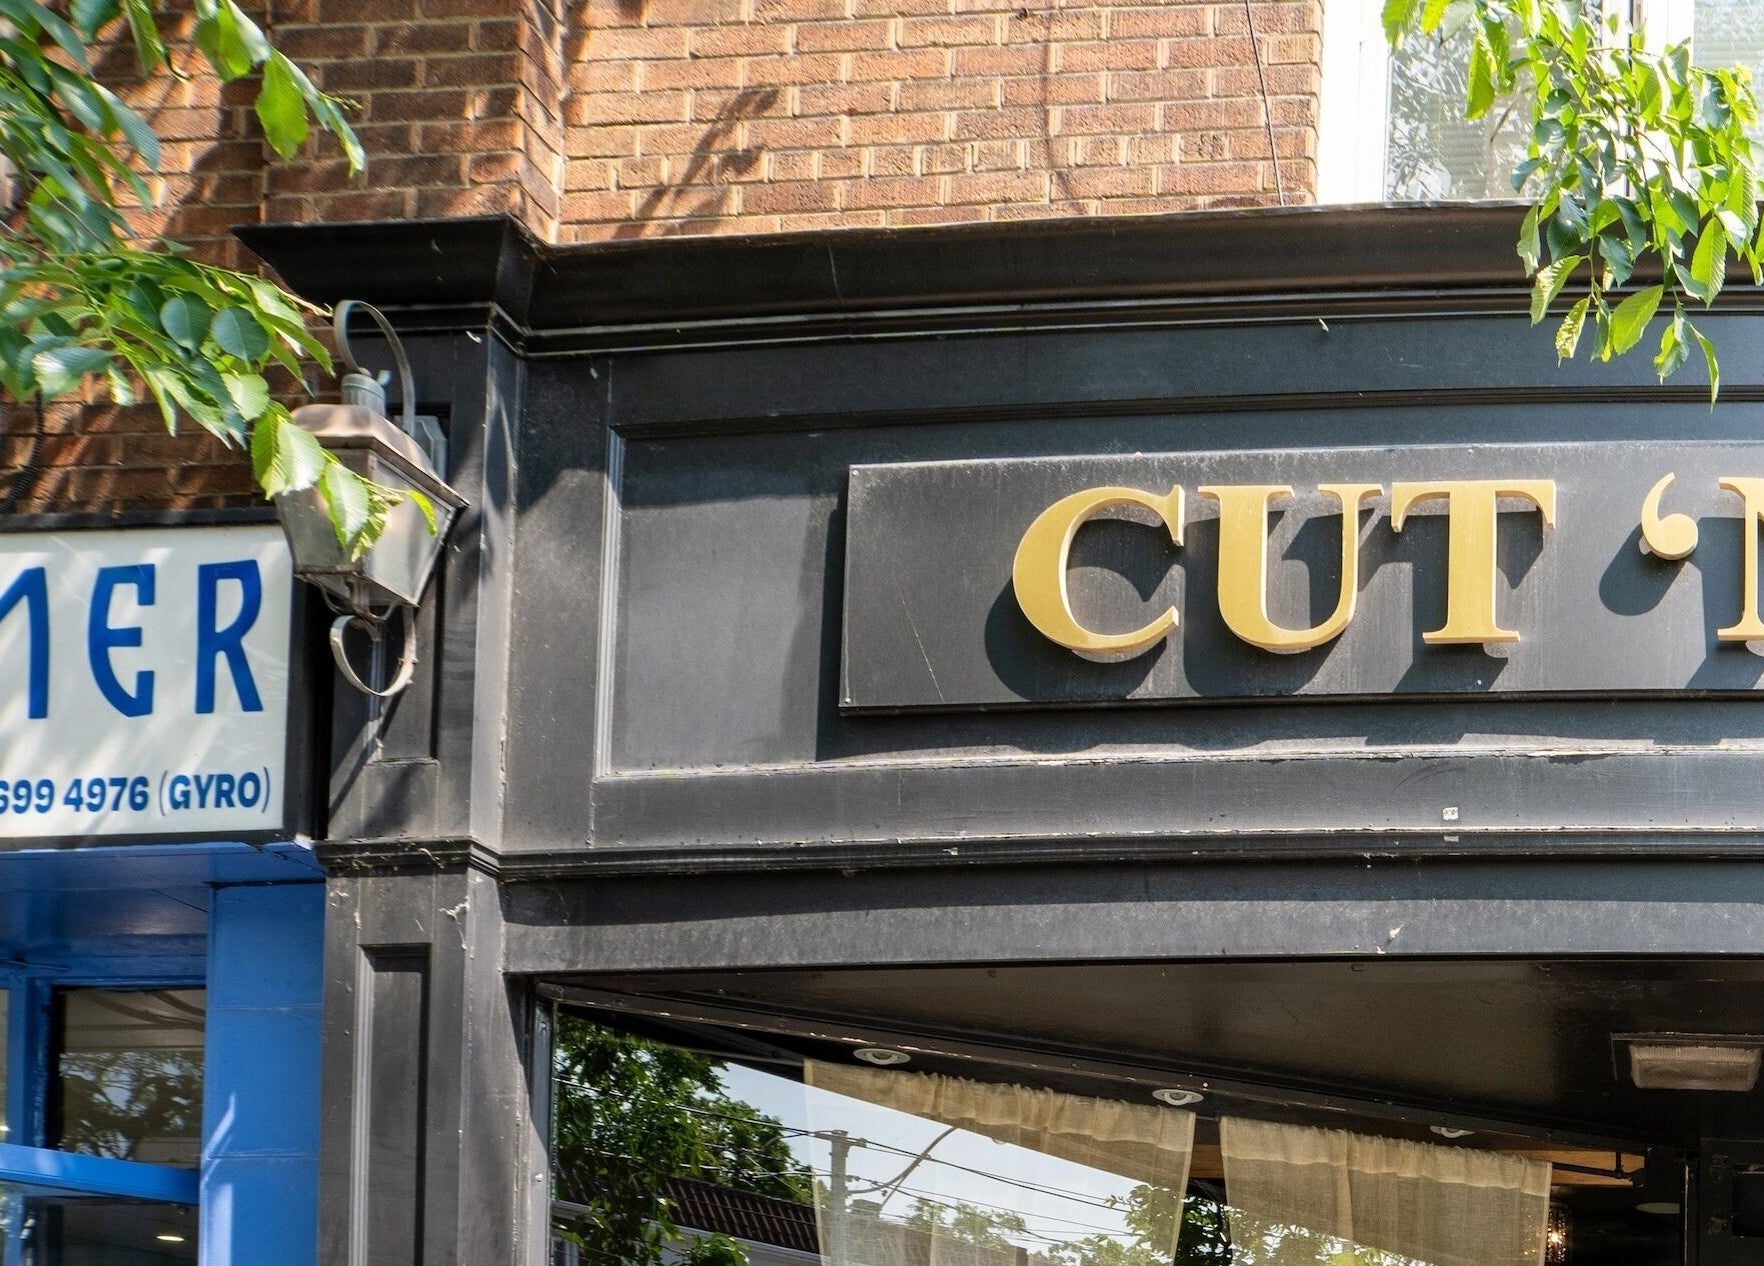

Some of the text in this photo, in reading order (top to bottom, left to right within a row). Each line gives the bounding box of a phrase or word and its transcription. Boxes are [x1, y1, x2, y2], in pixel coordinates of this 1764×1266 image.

[1012, 479, 1557, 656] CUT
[63, 775, 149, 813] 4976
[159, 766, 271, 817] (GYRO)
